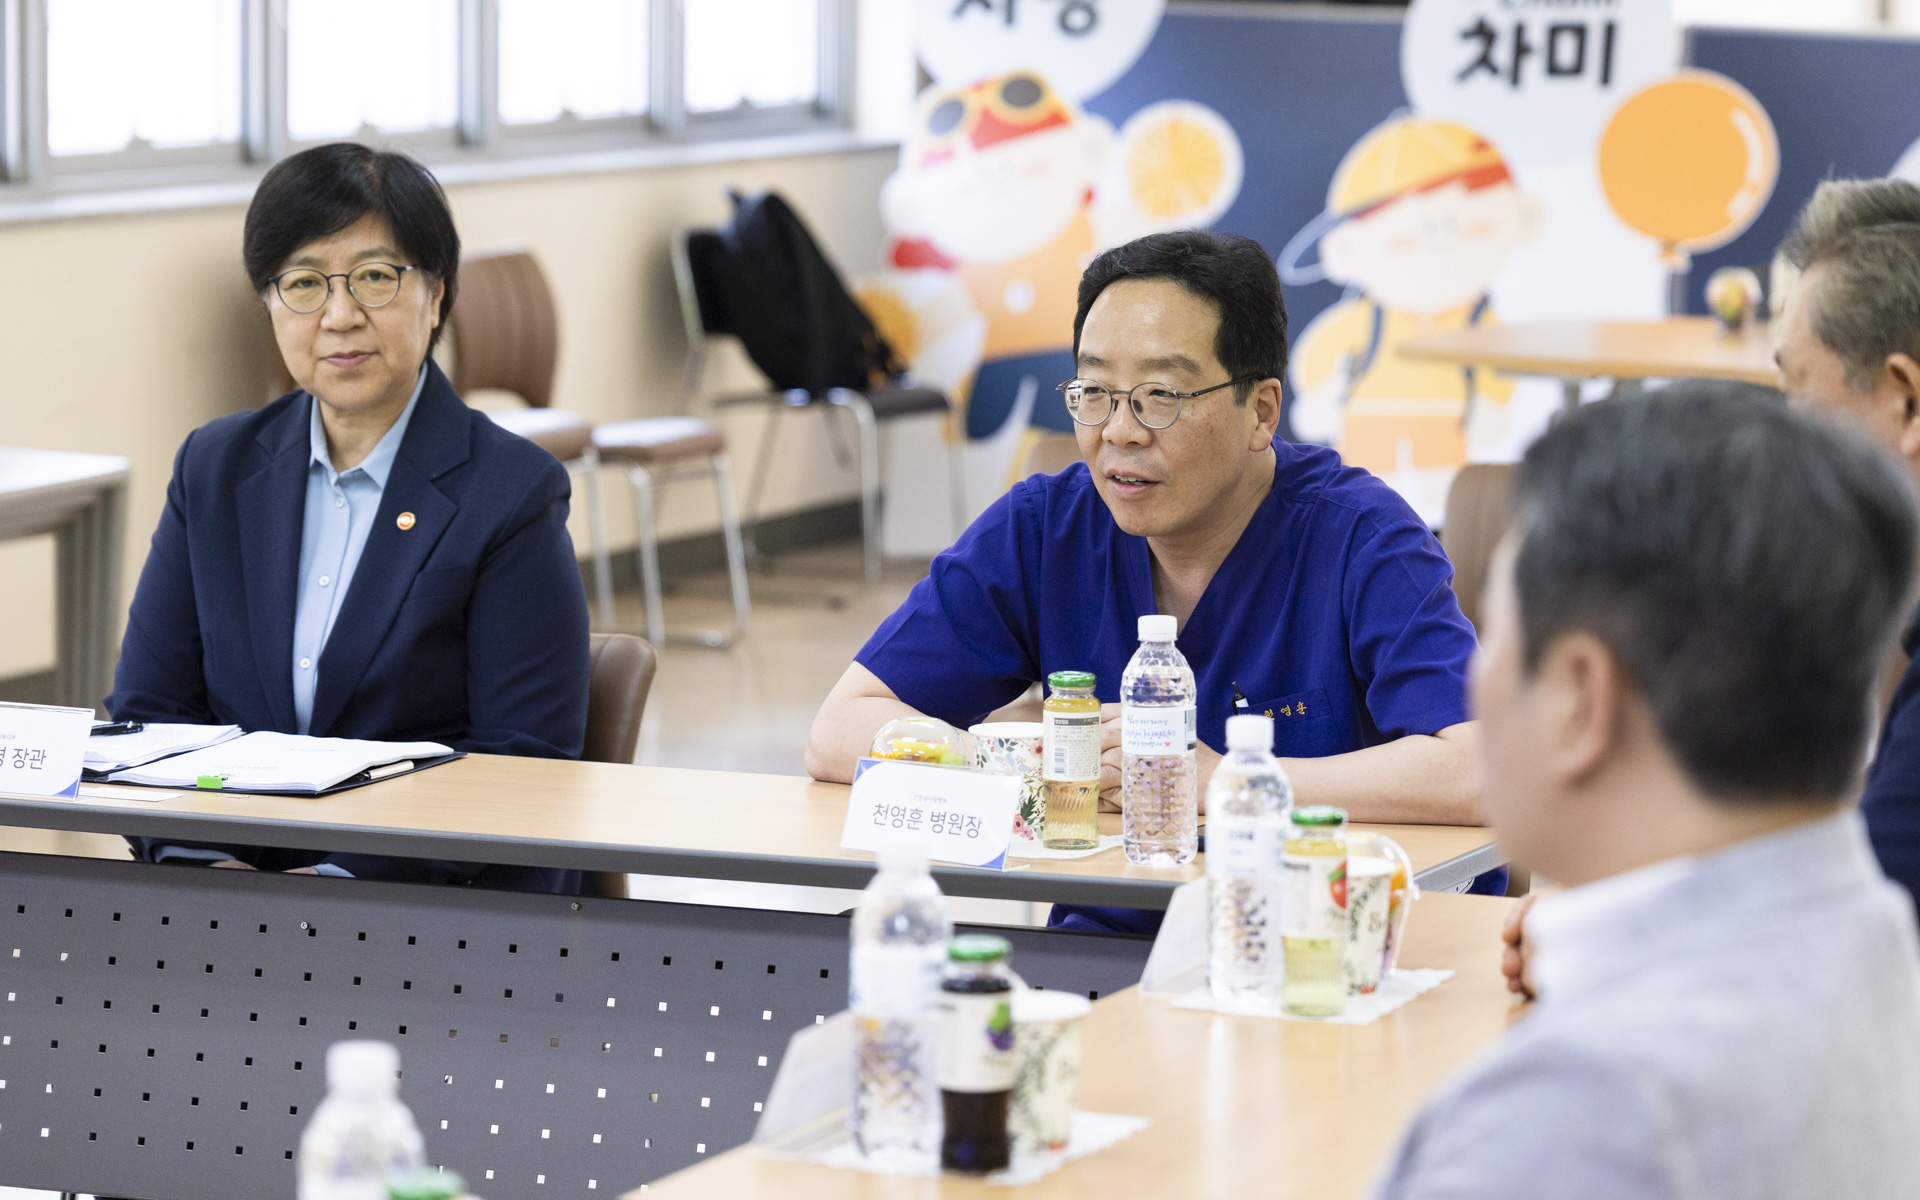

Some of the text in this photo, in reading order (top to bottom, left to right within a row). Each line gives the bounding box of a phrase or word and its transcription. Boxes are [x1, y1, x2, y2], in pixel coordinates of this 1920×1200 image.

[1457, 17, 1616, 87] 차미
[12, 748, 47, 770] 장관
[872, 802, 983, 839] 천영훈 병원장
